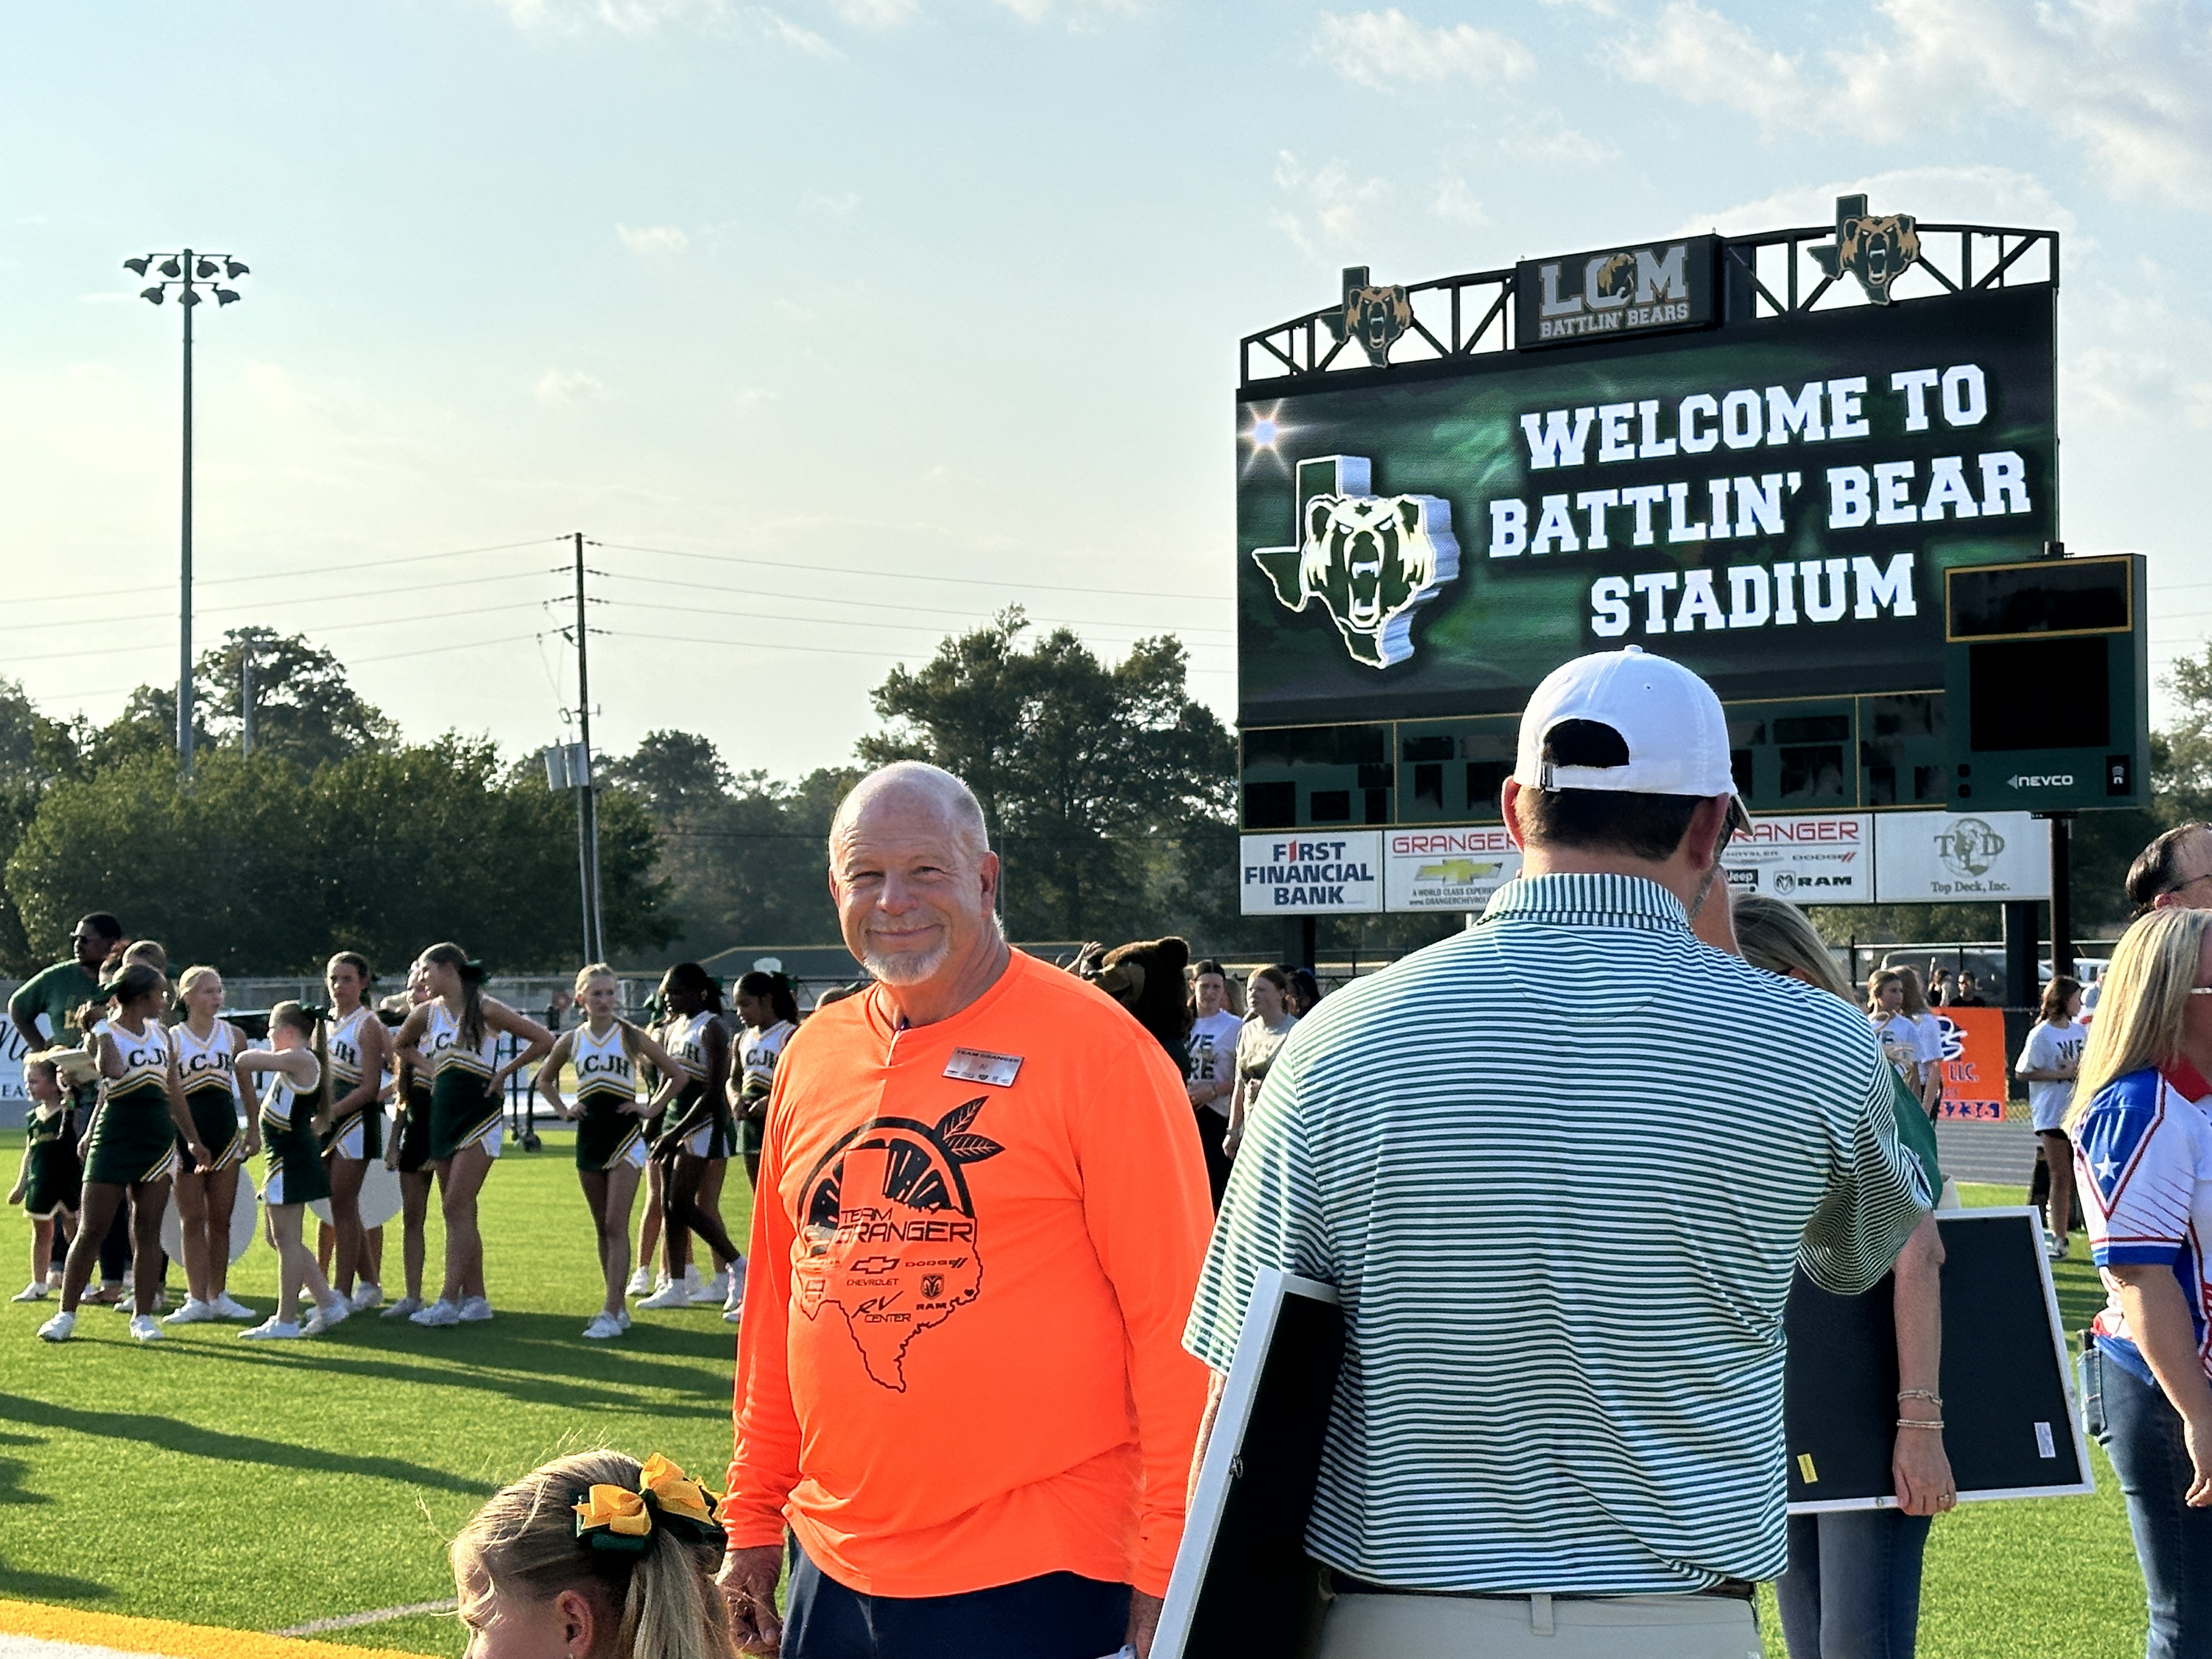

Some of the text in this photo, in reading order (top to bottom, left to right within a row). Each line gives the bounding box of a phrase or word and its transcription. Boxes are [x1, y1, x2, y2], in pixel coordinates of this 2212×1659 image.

[1539, 245, 1688, 318] LCM
[1540, 303, 1688, 338] BATTLIN' BEARS
[1520, 364, 1987, 470] WELCOME TO
[1489, 450, 2032, 558] BATTLIN' BEAR
[1591, 552, 1917, 637] STADIUM
[1273, 840, 1346, 864] FIRST
[1245, 863, 1374, 884] FINANCIAL
[1798, 876, 1852, 887] RAM
[1274, 886, 1344, 905] BANK
[1418, 888, 1441, 896] WORLD
[1931, 880, 2011, 894] Top Deck, Inc.
[575, 1054, 629, 1080] LCJH
[840, 1207, 893, 1223] TEAM
[835, 1221, 973, 1244] GRANGER
[847, 1278, 899, 1286] CHEVROLET
[851, 1290, 904, 1319] RV
[916, 1302, 947, 1311] RAM
[864, 1313, 911, 1323] CENTER
